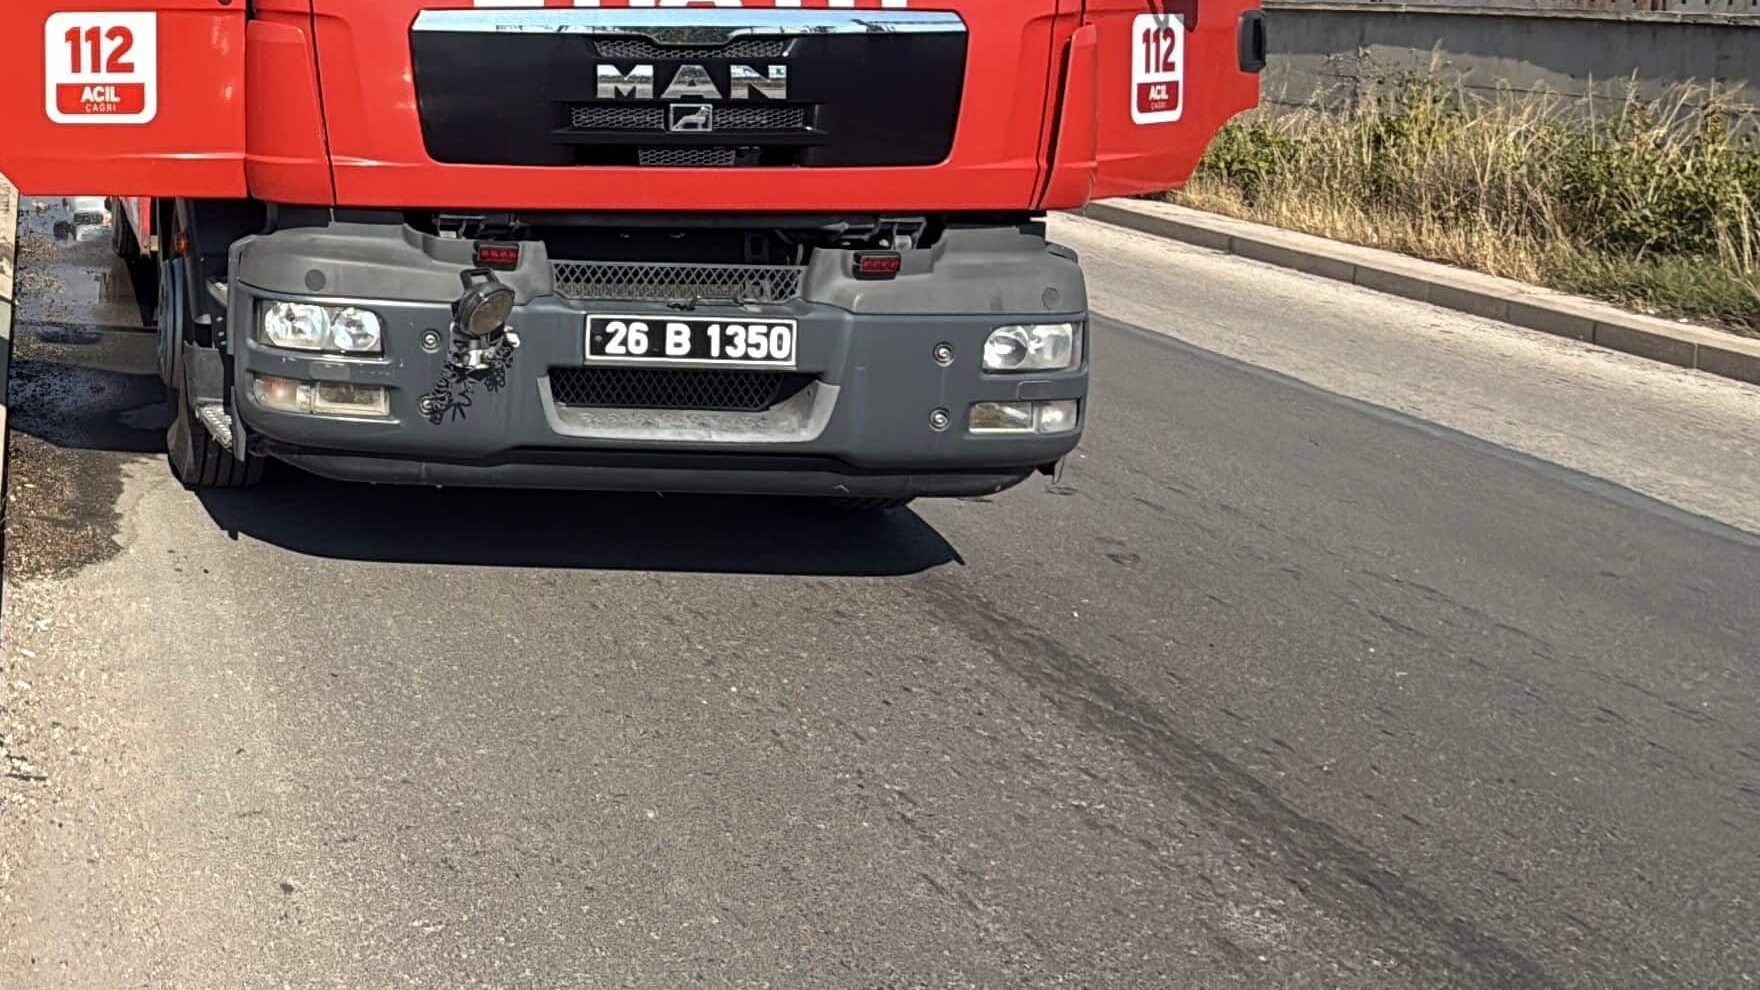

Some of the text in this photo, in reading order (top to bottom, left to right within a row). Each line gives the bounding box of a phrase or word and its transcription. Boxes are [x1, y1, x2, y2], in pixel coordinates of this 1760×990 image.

[64, 26, 135, 74] 112
[1142, 26, 1176, 74] 112
[596, 65, 787, 99] MAN
[604, 321, 791, 359] 26 B 1350
